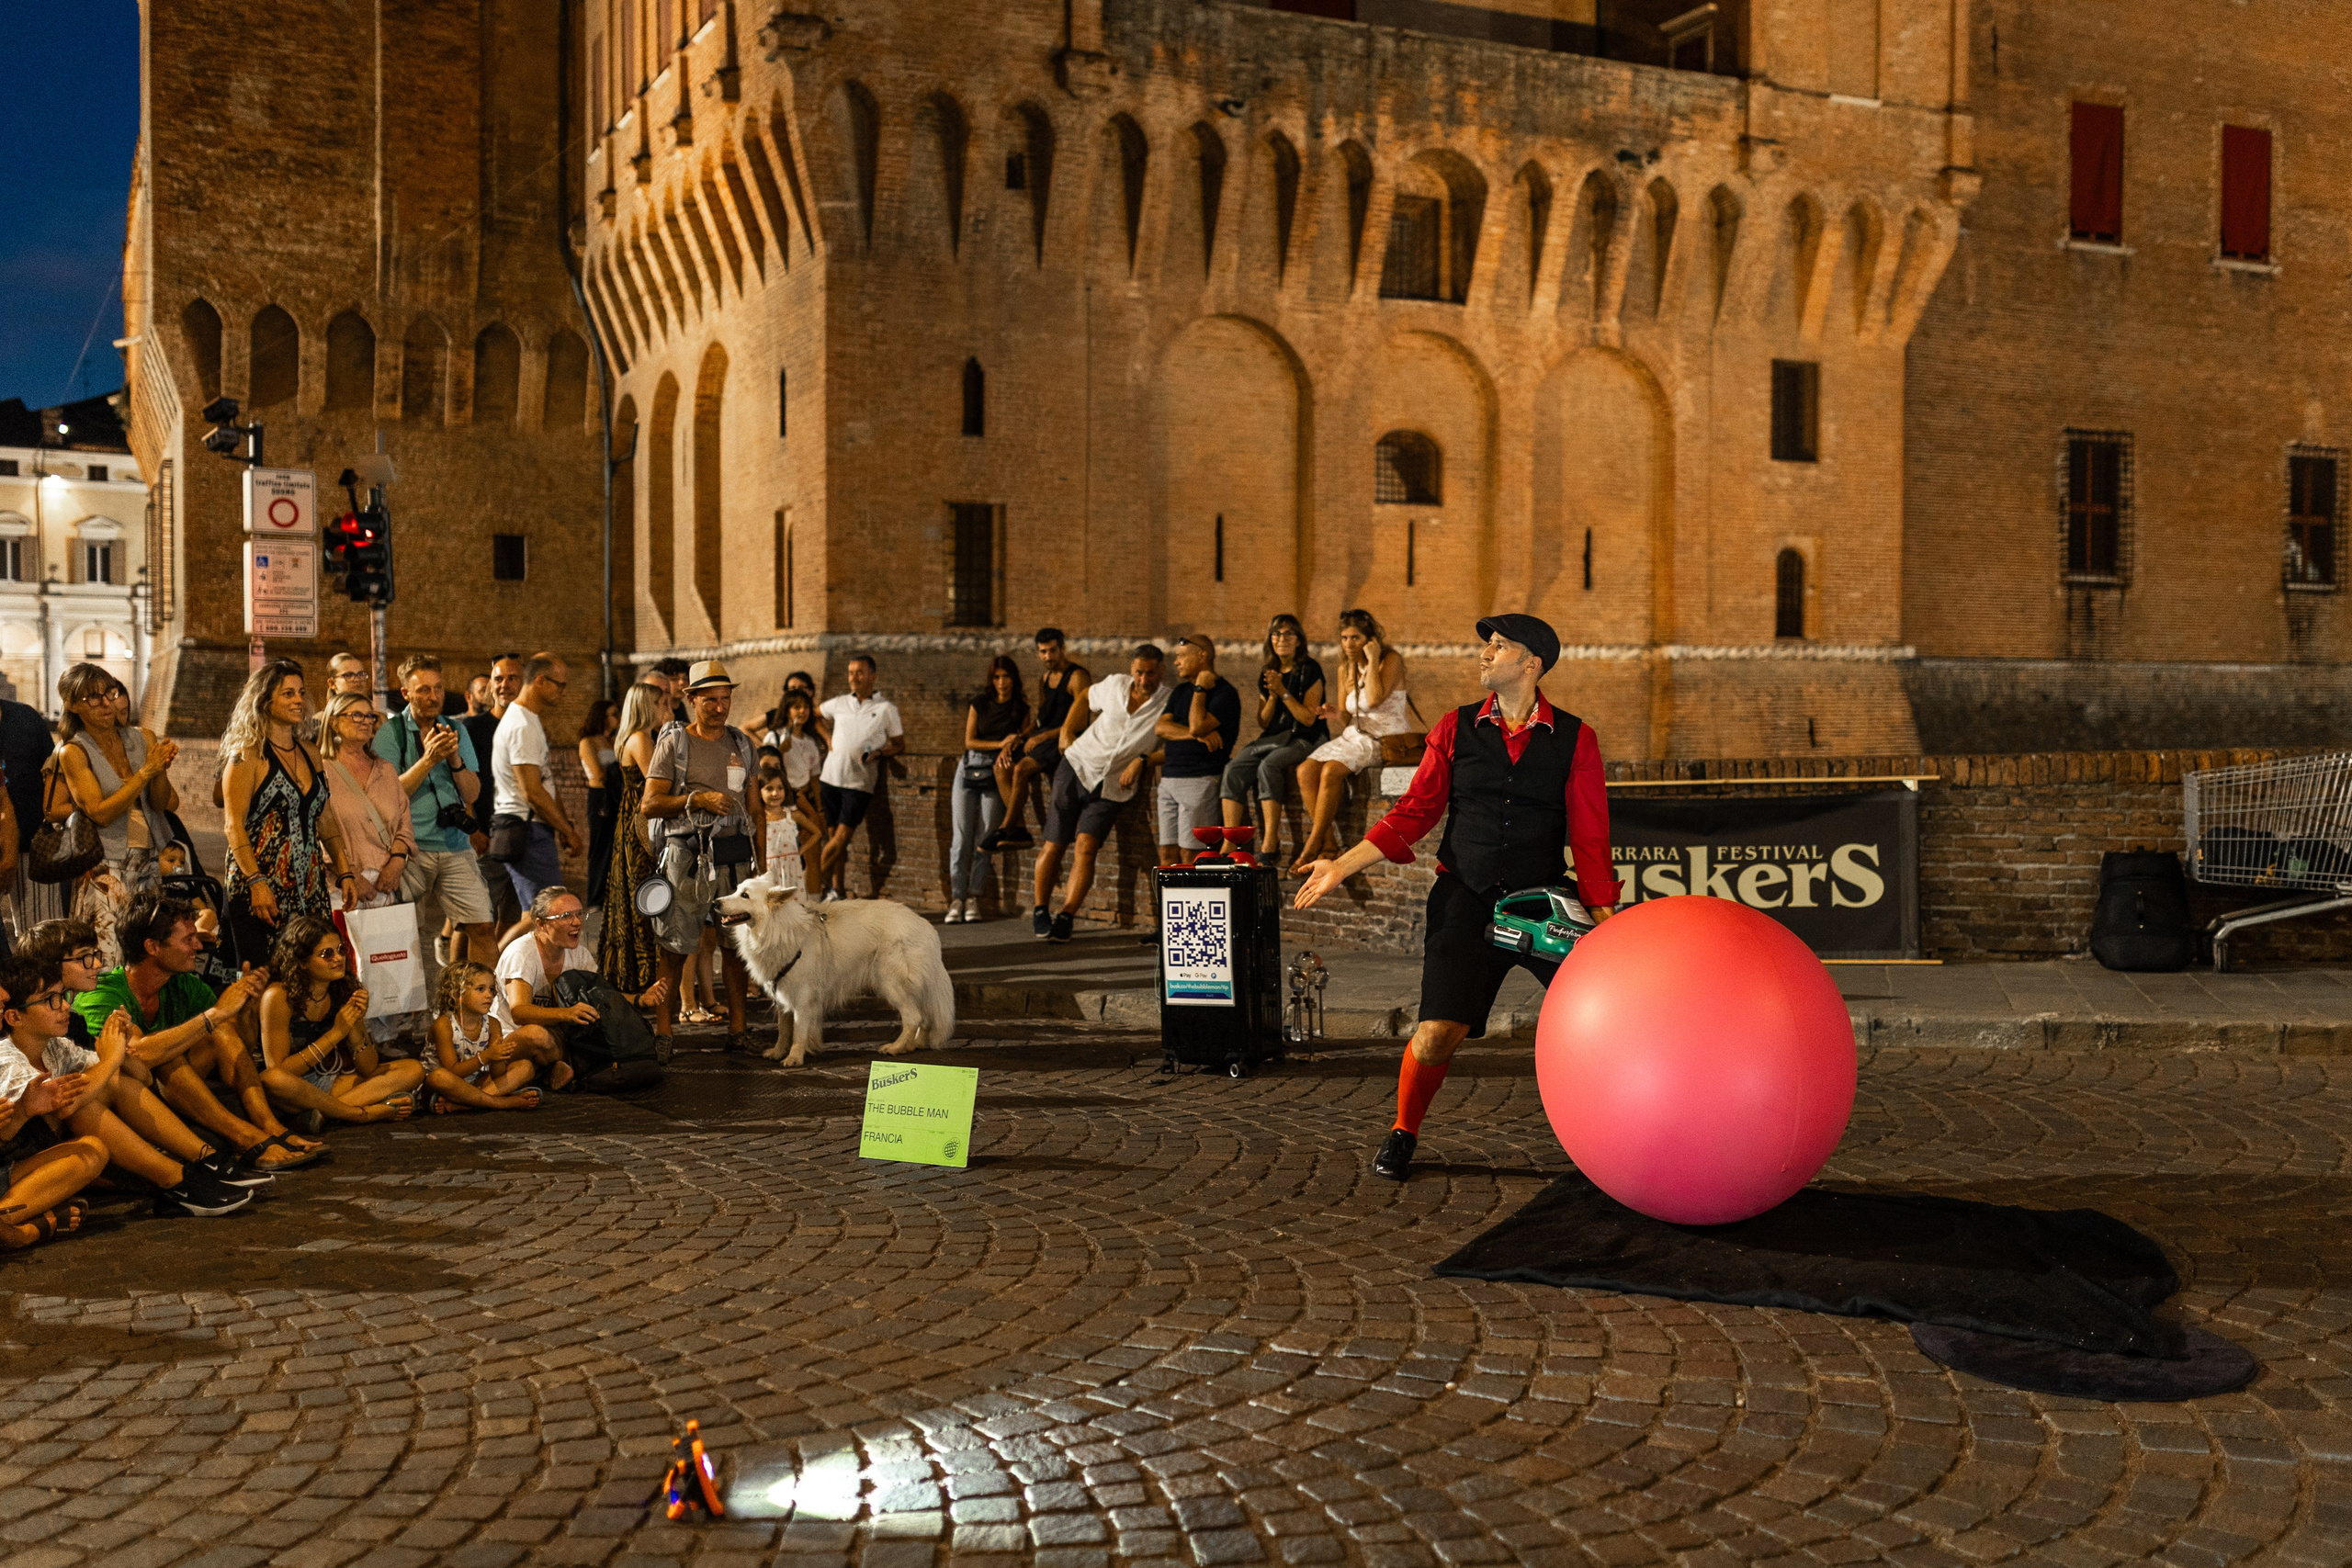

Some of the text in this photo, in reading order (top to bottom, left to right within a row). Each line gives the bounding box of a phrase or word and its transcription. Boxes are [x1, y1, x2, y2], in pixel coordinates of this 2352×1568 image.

[1611, 845, 1824, 861] RRARA FESTIVAL
[1564, 843, 1884, 908] skerS
[871, 1067, 918, 1091] BuskerS
[867, 1102, 949, 1120] THE BUBBLE MAN
[864, 1131, 903, 1145] FRANCIA
